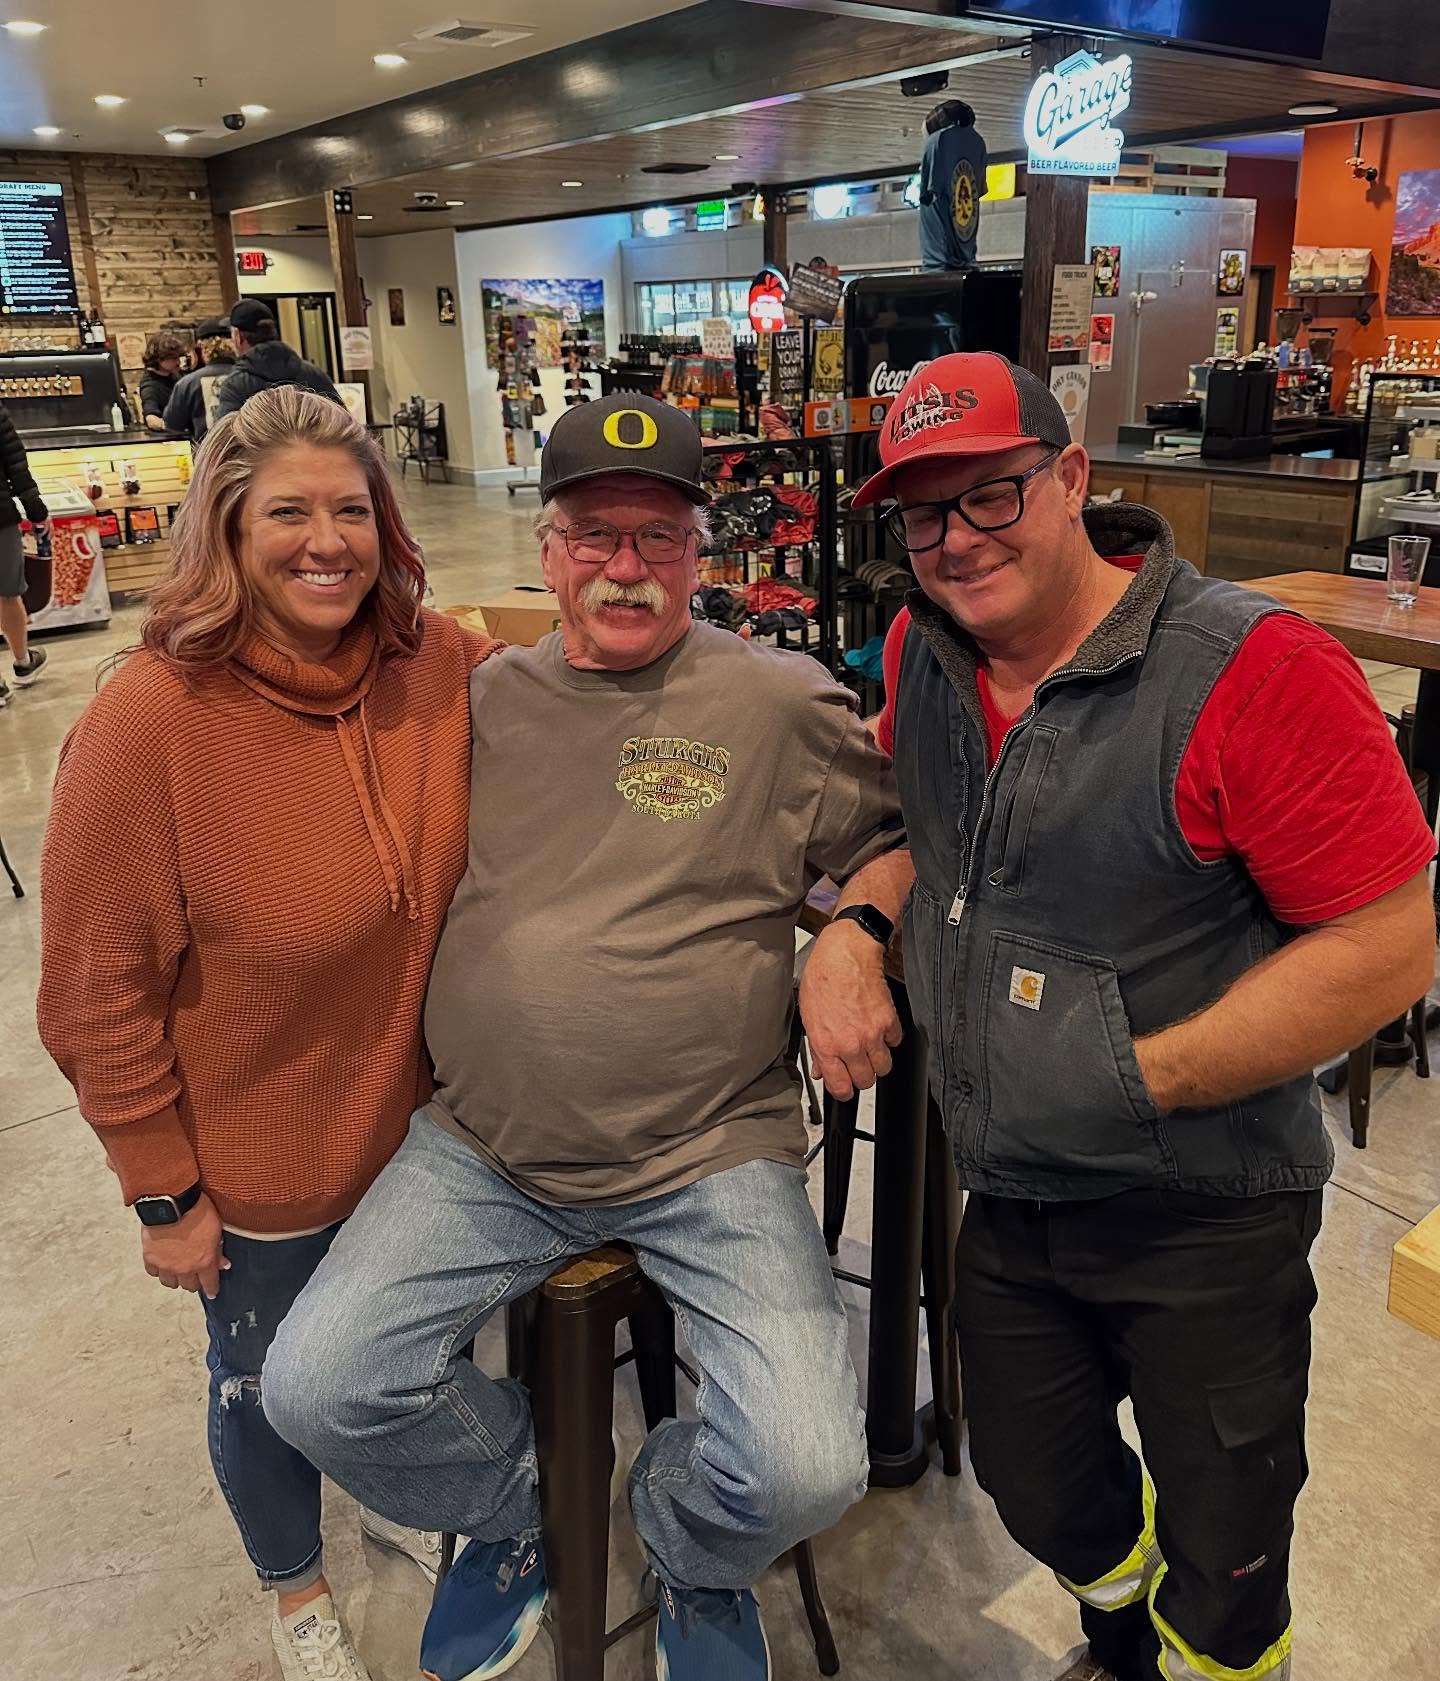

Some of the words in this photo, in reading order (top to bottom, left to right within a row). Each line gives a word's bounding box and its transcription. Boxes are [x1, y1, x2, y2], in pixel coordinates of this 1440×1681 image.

[1036, 63, 1132, 144] Garage
[1030, 159, 1052, 169] BEER
[1053, 160, 1094, 170] FLAVORED
[1096, 162, 1117, 171] BEER
[242, 252, 264, 270] EXIT
[775, 334, 800, 349] LEAVE
[1052, 376, 1065, 391] DRY
[602, 408, 659, 449] O
[895, 410, 963, 446] TOWING
[618, 737, 730, 775] STURGIS
[643, 782, 701, 798] HARLEY-DAVIDSON
